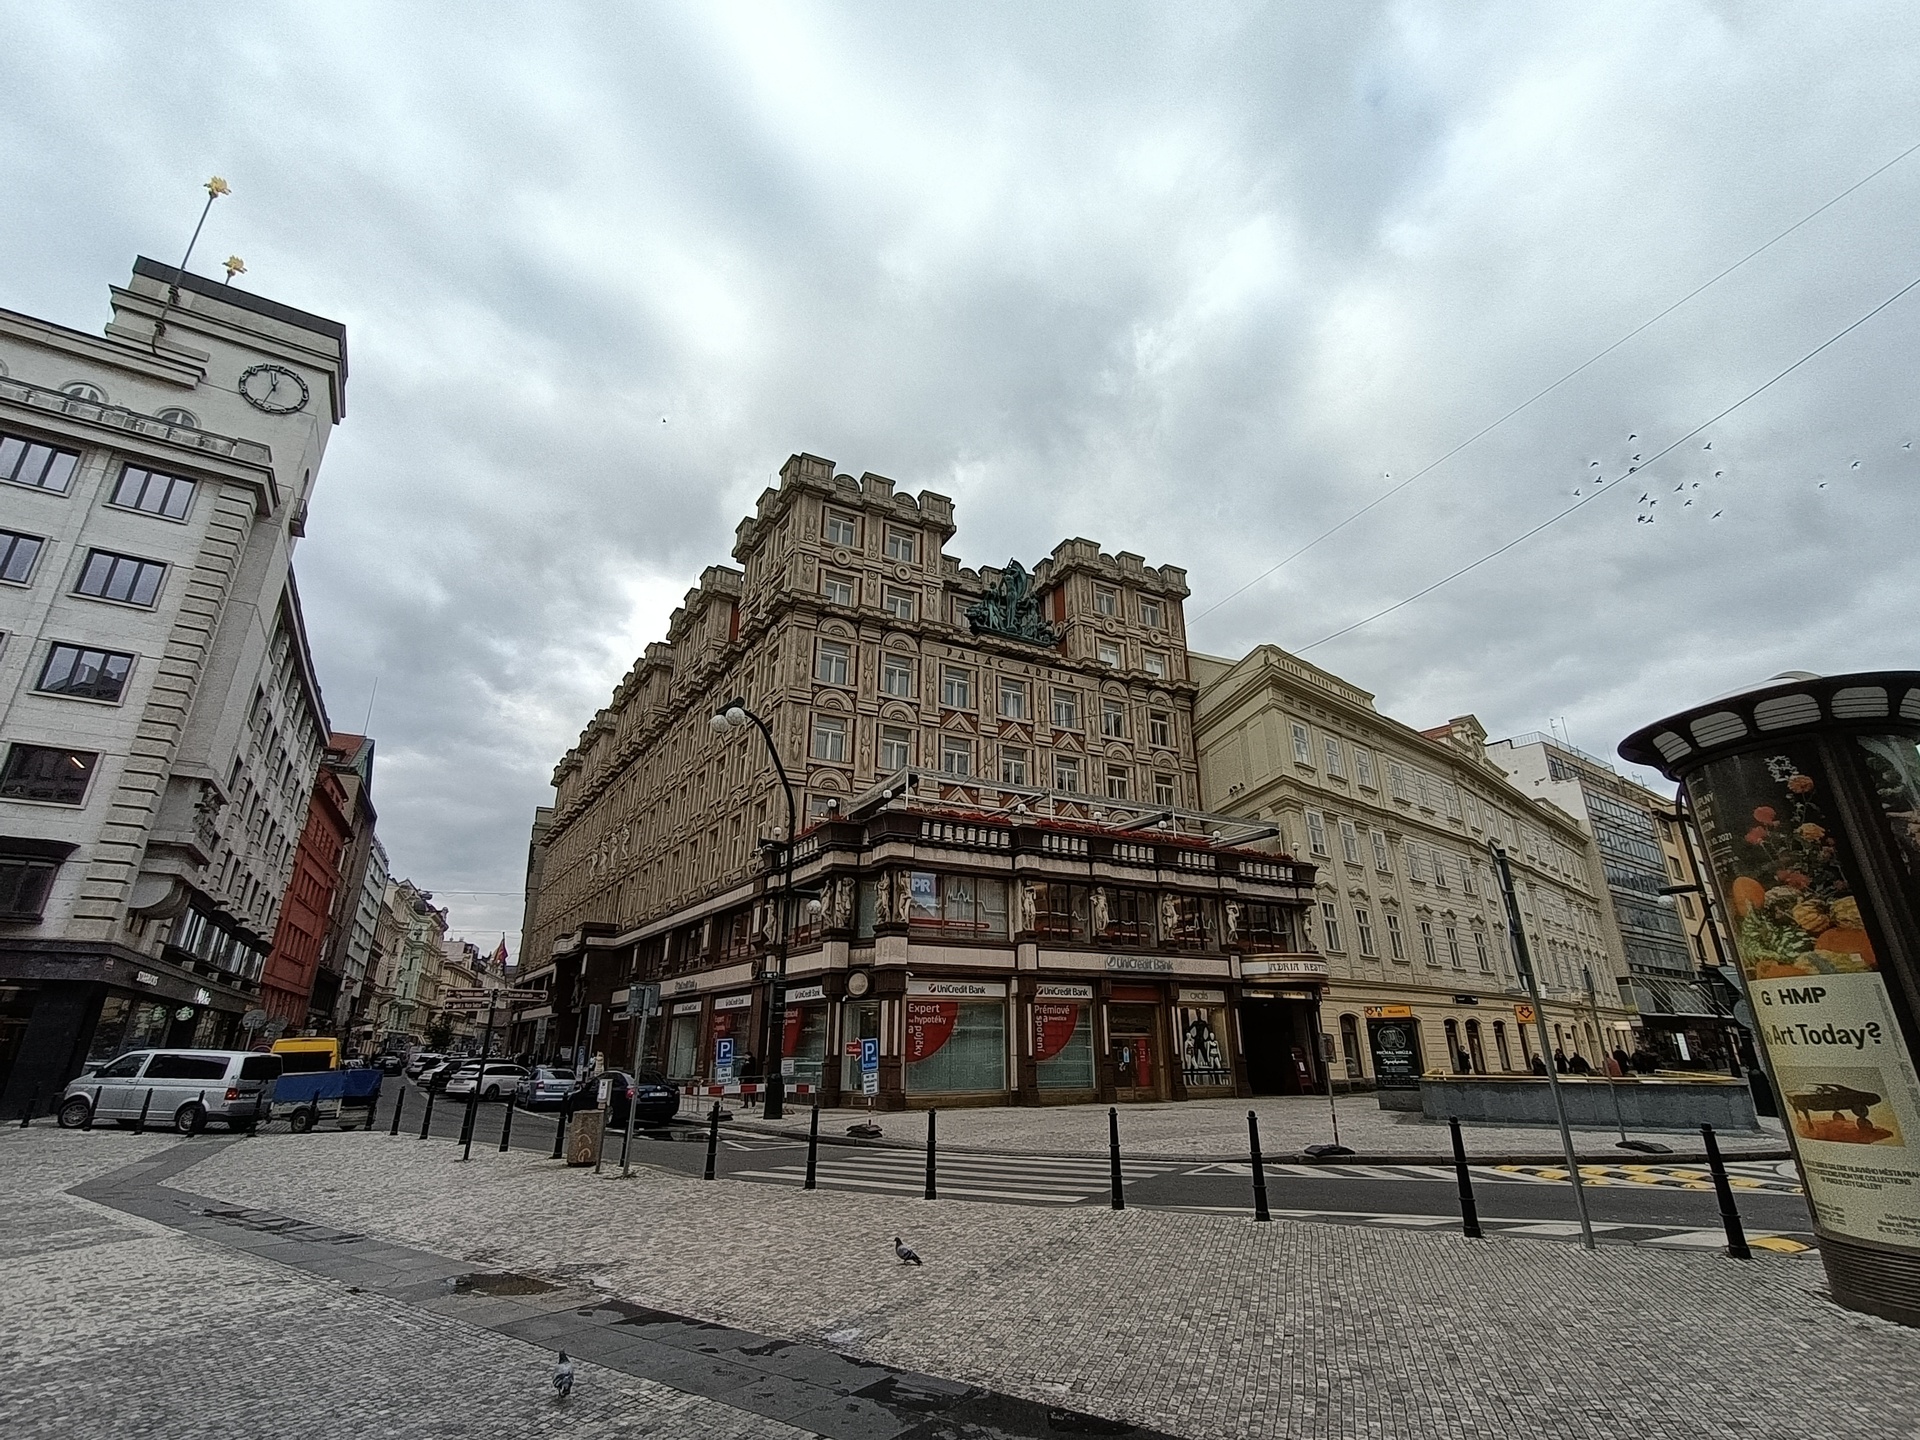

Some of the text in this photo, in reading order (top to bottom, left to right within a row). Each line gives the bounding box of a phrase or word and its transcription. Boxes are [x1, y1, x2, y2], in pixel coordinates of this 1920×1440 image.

[1116, 957, 1174, 971] UniCredit Bank
[1269, 963, 1300, 971] ADRIA
[936, 984, 986, 994] UniCredit Bank
[1044, 986, 1088, 996] UniCredit Bank
[1777, 986, 1827, 1005] HMP
[908, 1003, 940, 1014] Expert
[1034, 1004, 1070, 1014] Prémiové
[914, 1015, 946, 1024] hypotéky
[908, 1025, 924, 1056] a půjčky
[1772, 1024, 1798, 1046] Art
[1795, 1022, 1882, 1050] Today?
[720, 1042, 730, 1058] P
[864, 1042, 875, 1062] P
[1856, 1181, 1882, 1190] GALLERY
[1864, 1175, 1911, 1186] COLLECTIONS
